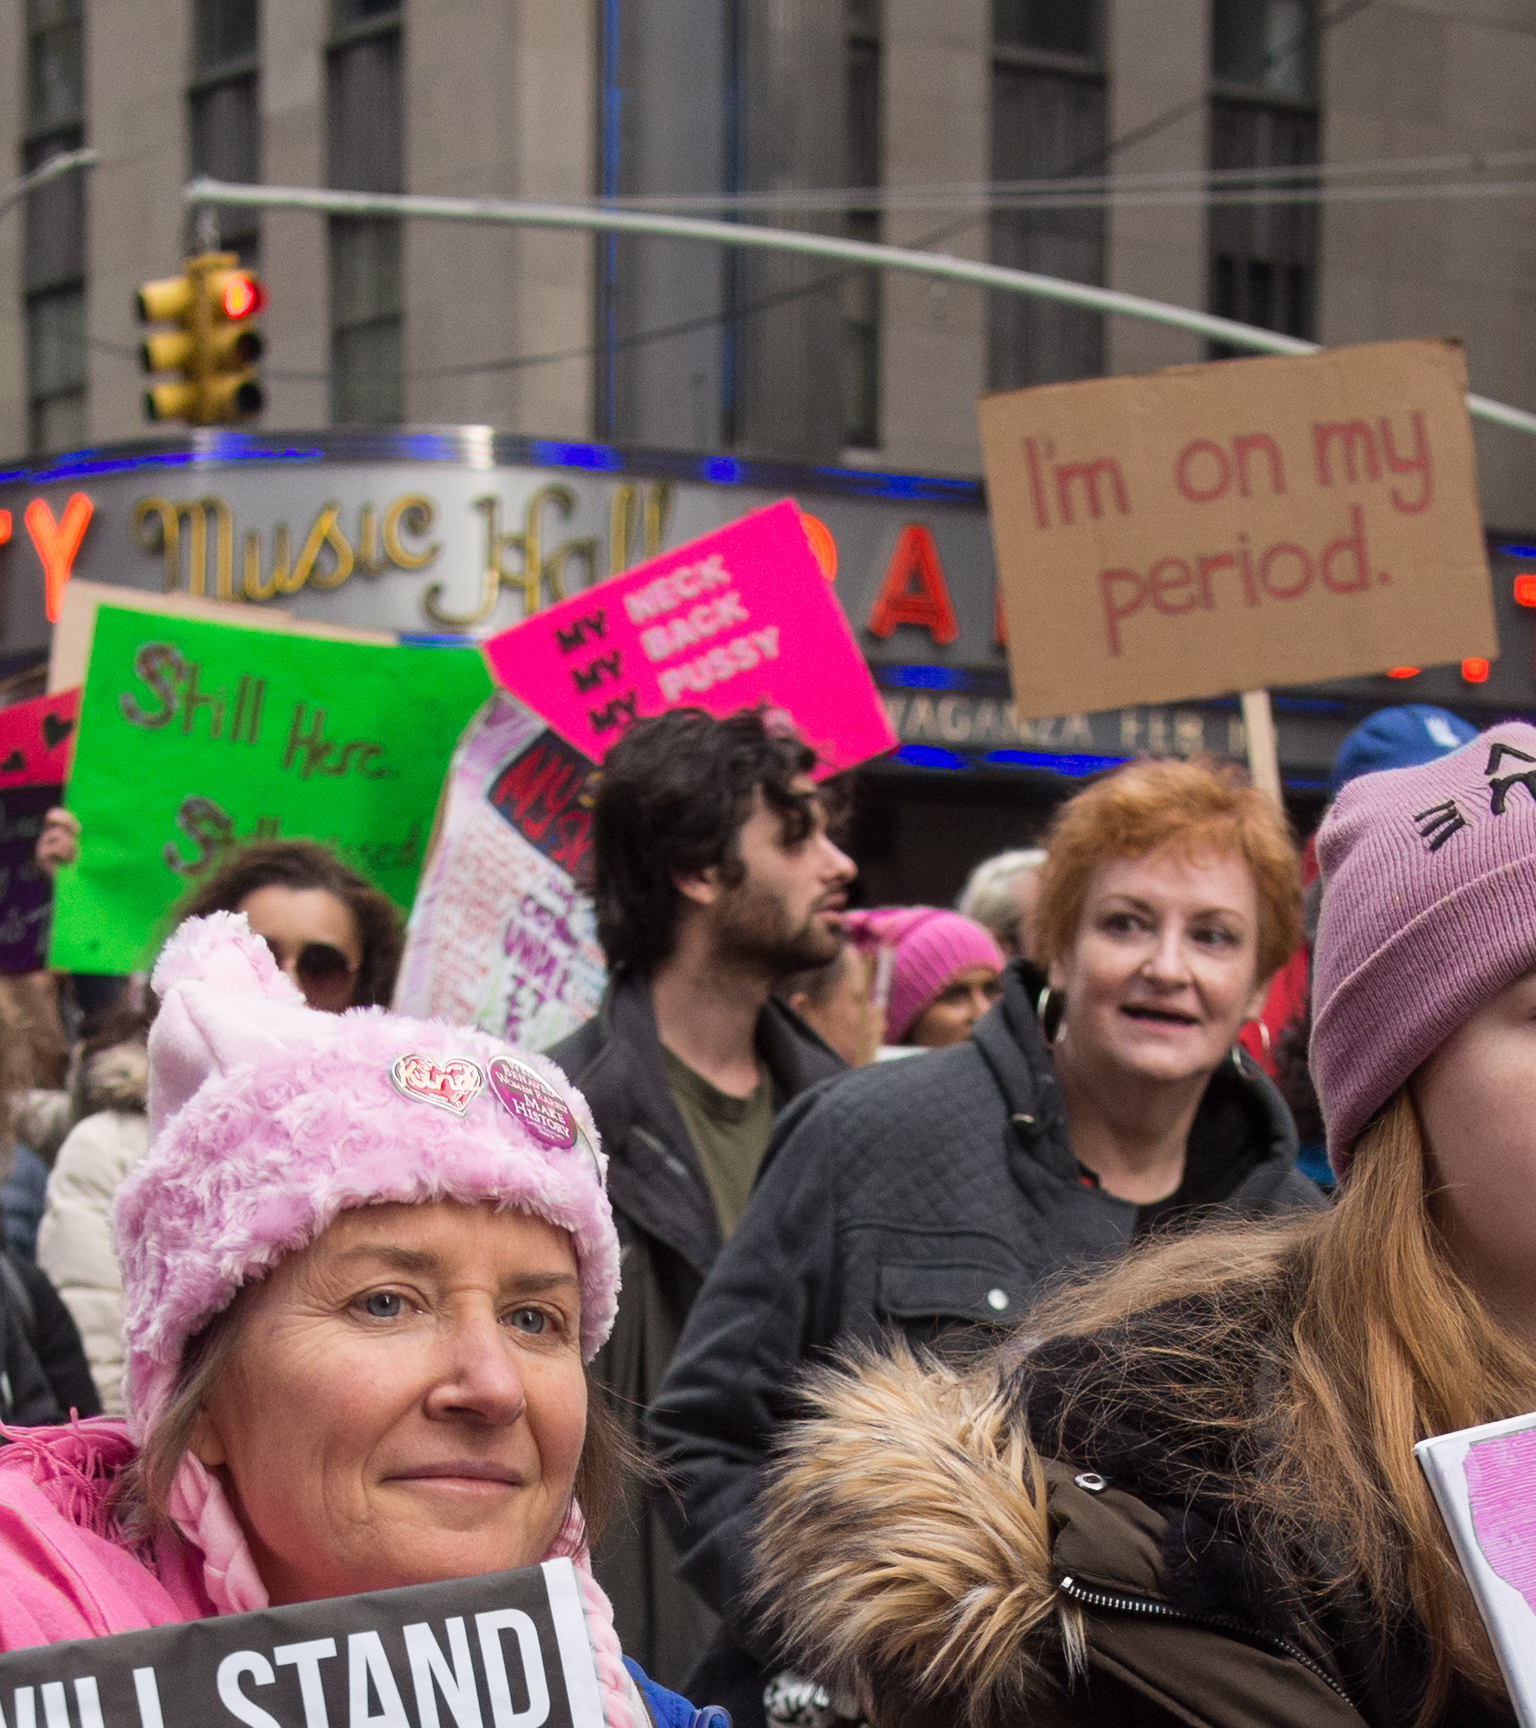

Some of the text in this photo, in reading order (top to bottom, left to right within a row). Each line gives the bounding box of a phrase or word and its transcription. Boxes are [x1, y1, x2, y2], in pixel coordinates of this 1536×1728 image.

[1023, 411, 1434, 530] I'm on my
[131, 493, 440, 601] Music
[423, 481, 674, 628] Hall
[555, 608, 606, 653] MY
[622, 553, 731, 624] NECK
[1100, 505, 1392, 658] period.
[118, 642, 265, 745] Still
[571, 592, 750, 693] MY BACK
[658, 625, 779, 703] PUSSY
[512, 1098, 570, 1138] HISTORY
